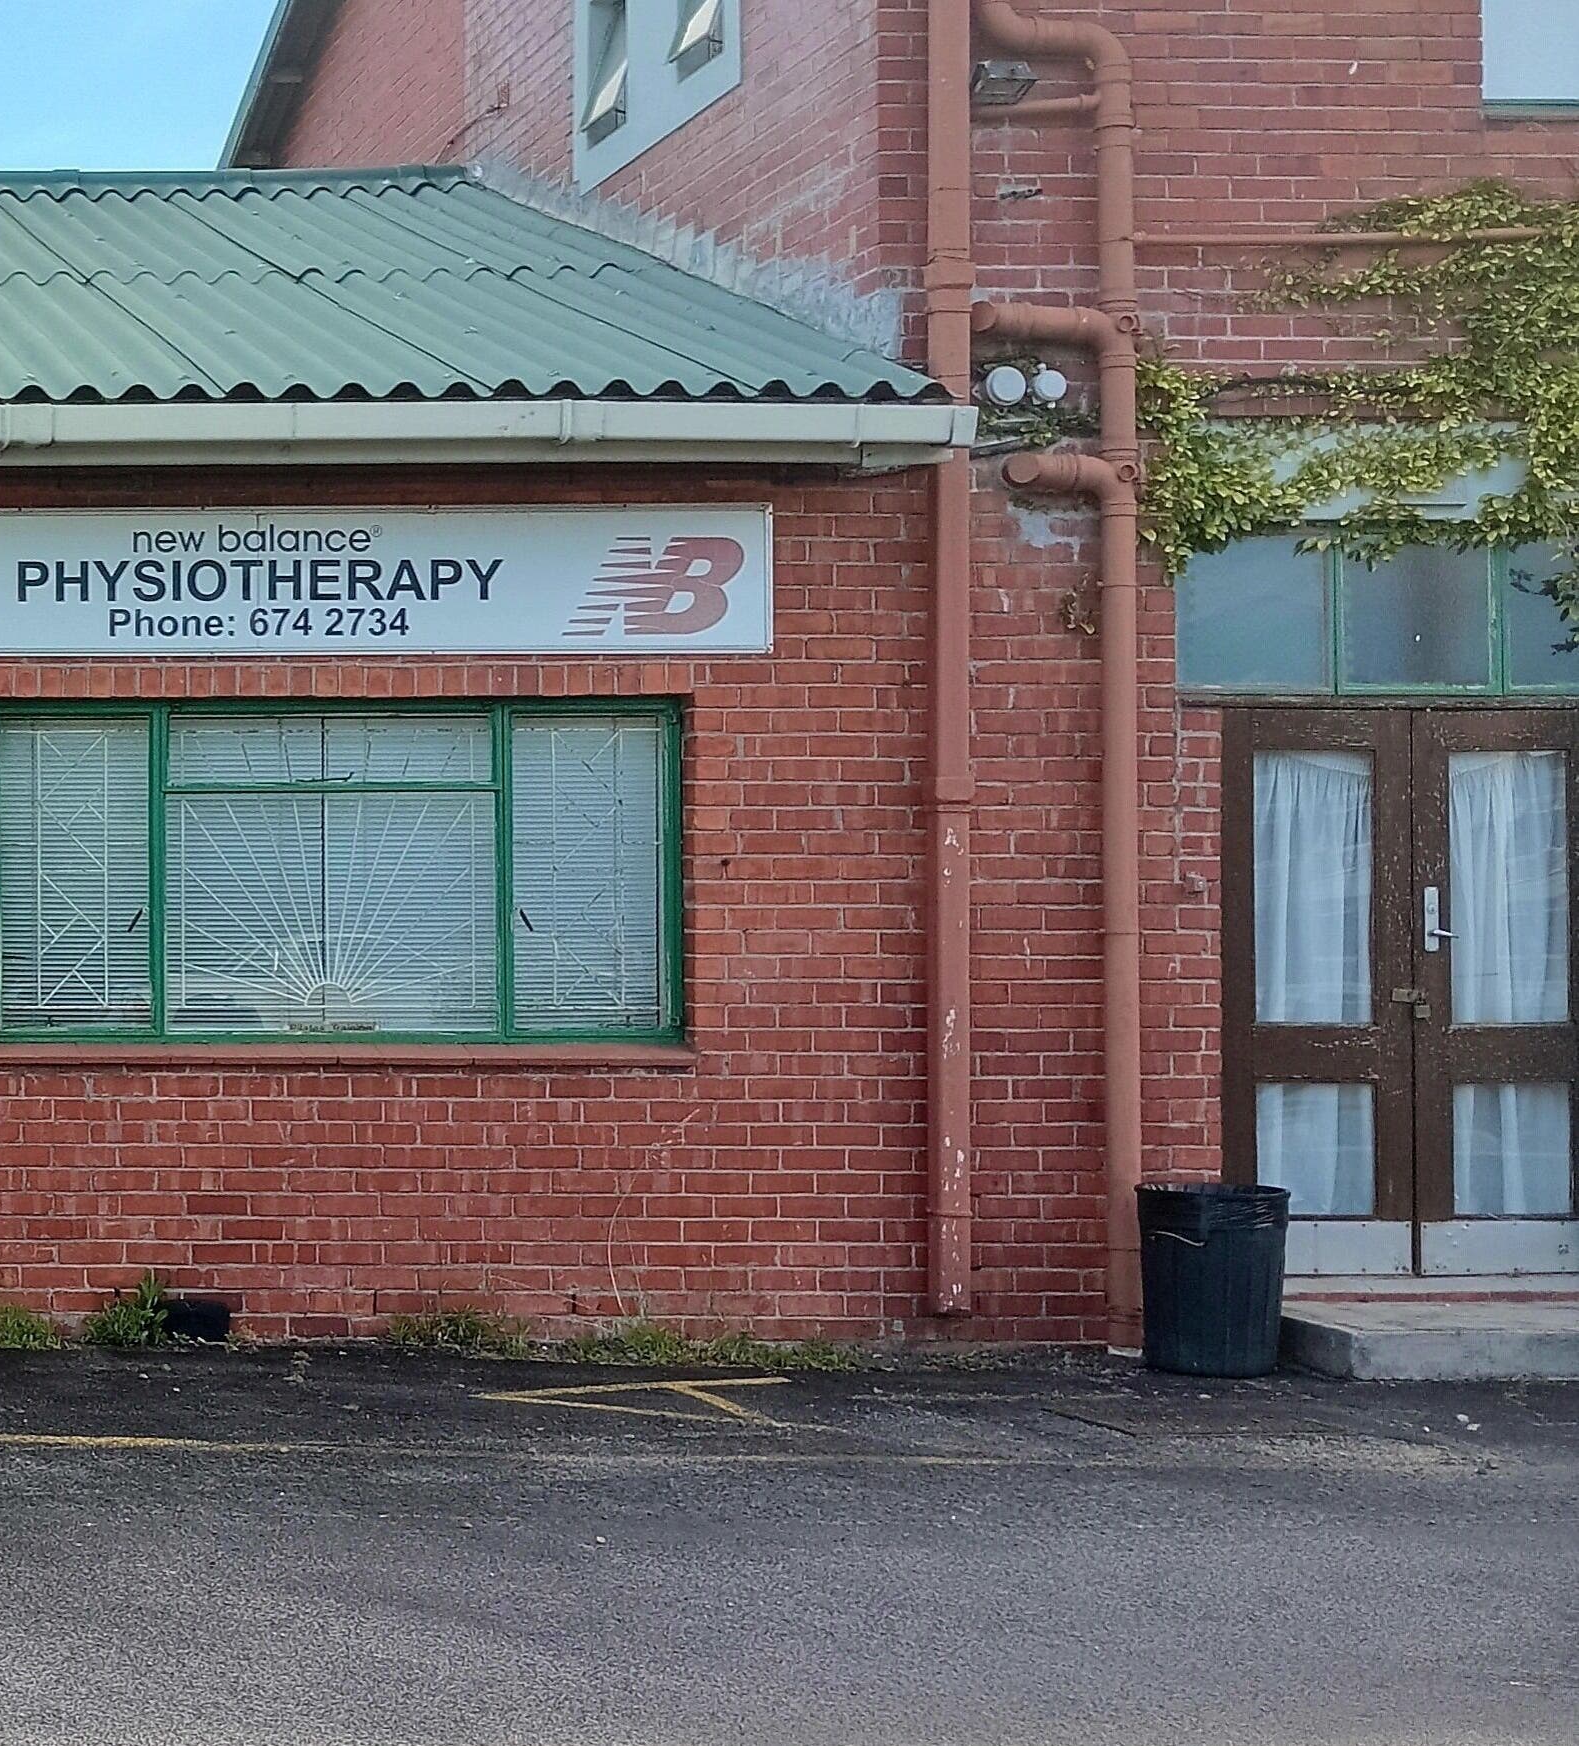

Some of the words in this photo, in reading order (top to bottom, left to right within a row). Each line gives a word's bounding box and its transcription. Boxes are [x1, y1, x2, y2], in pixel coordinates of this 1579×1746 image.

[132, 530, 206, 553] new
[17, 559, 504, 602] PHYSIOTHERAPY
[109, 608, 236, 637] Phone:
[249, 607, 313, 637] 674
[324, 607, 410, 637] 2734
